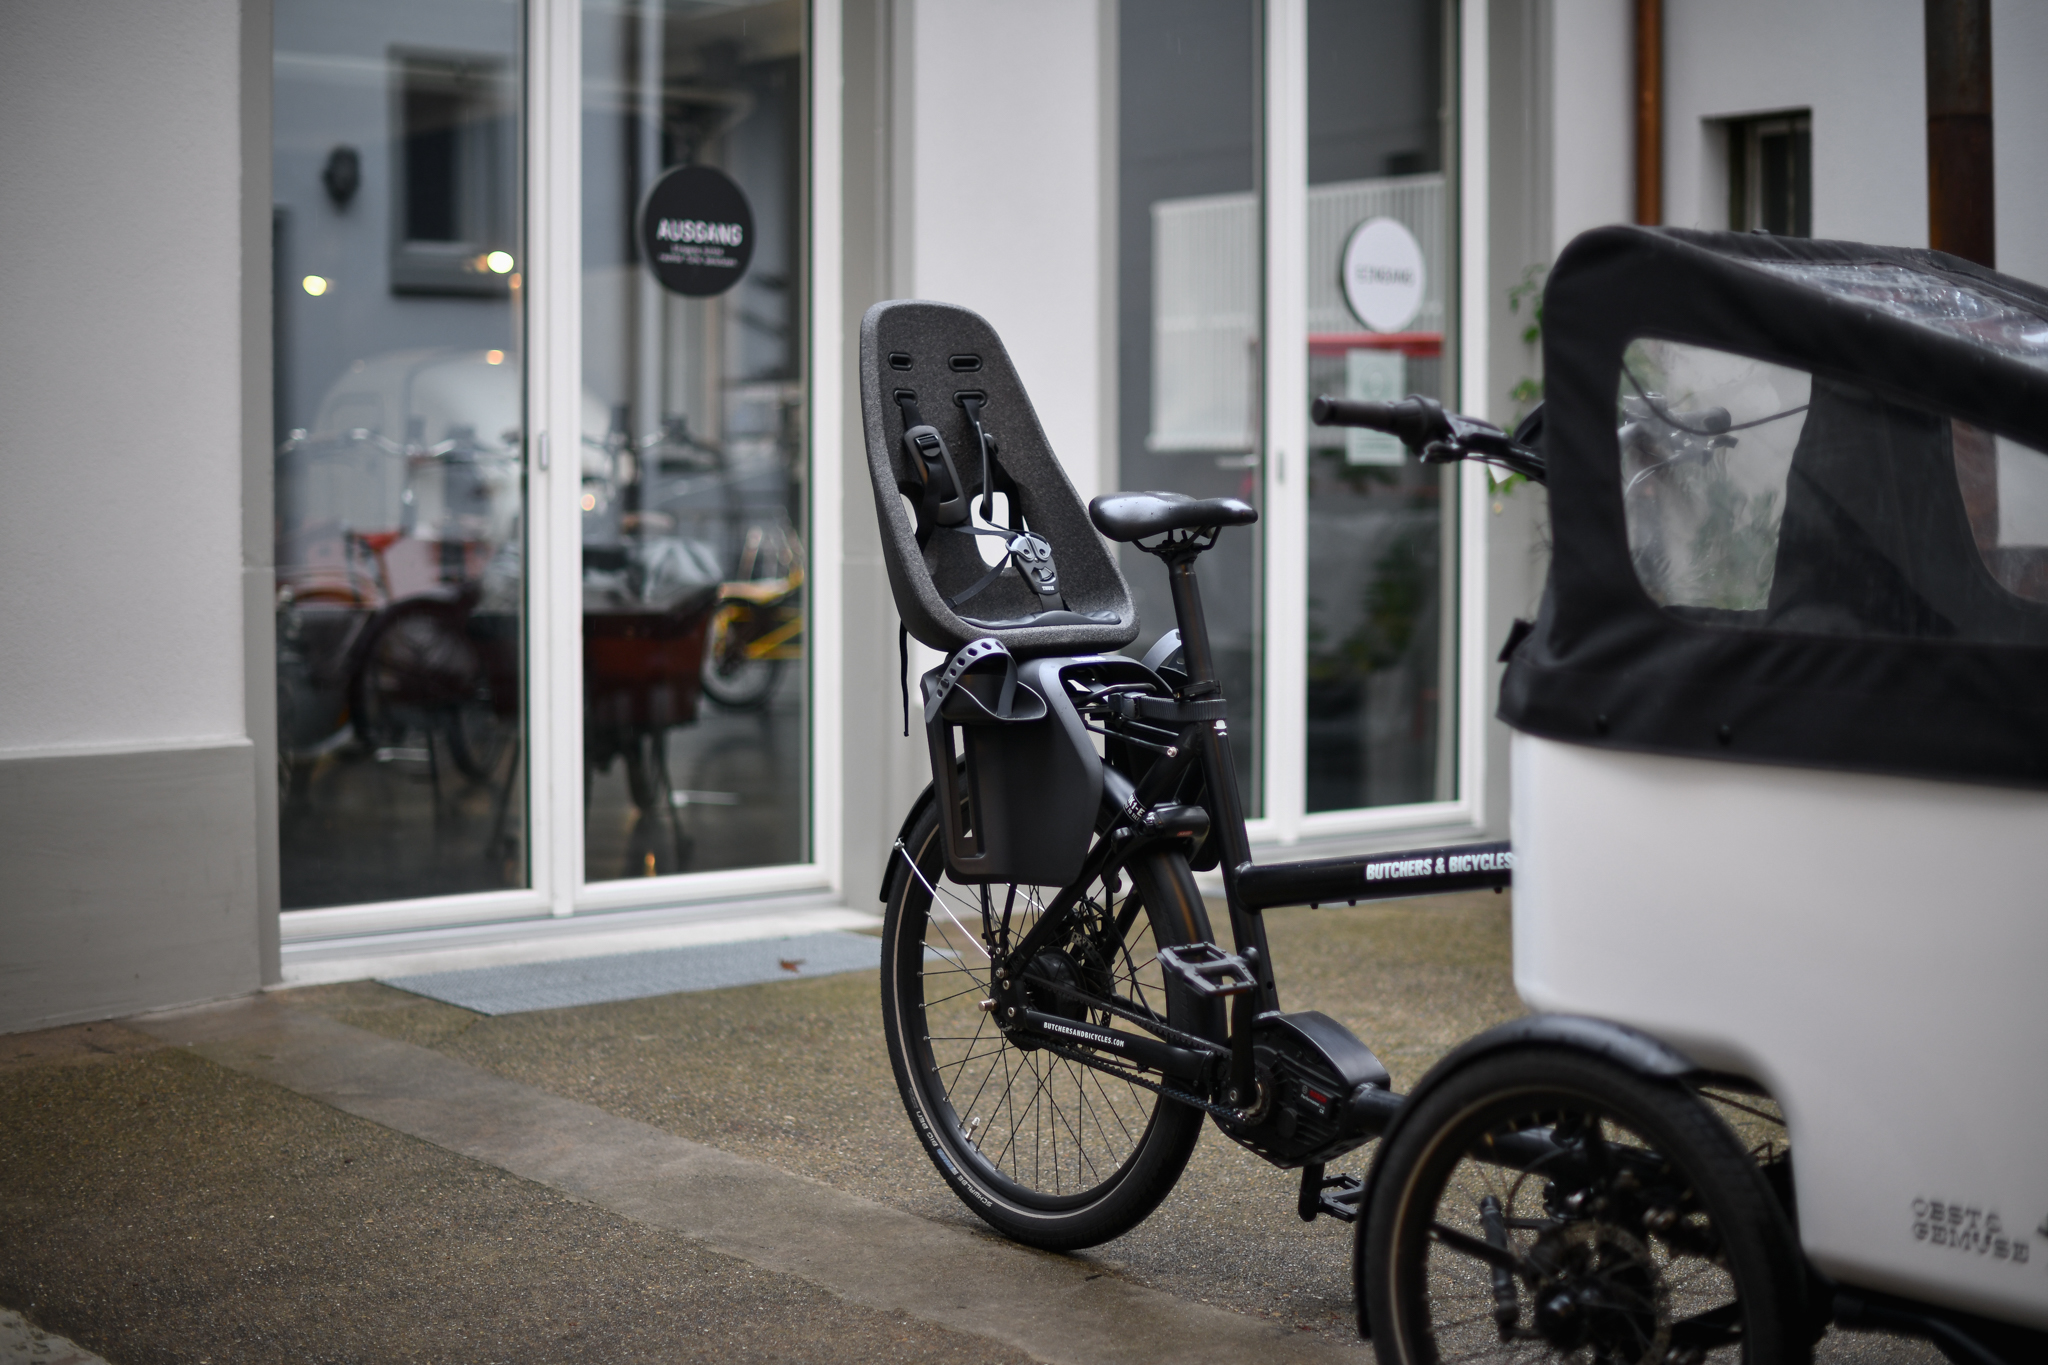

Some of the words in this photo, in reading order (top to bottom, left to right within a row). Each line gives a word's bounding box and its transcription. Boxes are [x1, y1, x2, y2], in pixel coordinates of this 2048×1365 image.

[657, 217, 743, 247] AUSGANG
[1366, 858, 1432, 880] BUTCHERS
[1434, 857, 1446, 874] &
[1448, 852, 1515, 873] BICYCLES
[1043, 1021, 1125, 1048] BUTCHERSANDBICYCLES.COM
[957, 1175, 993, 1208] SCHWALBE
